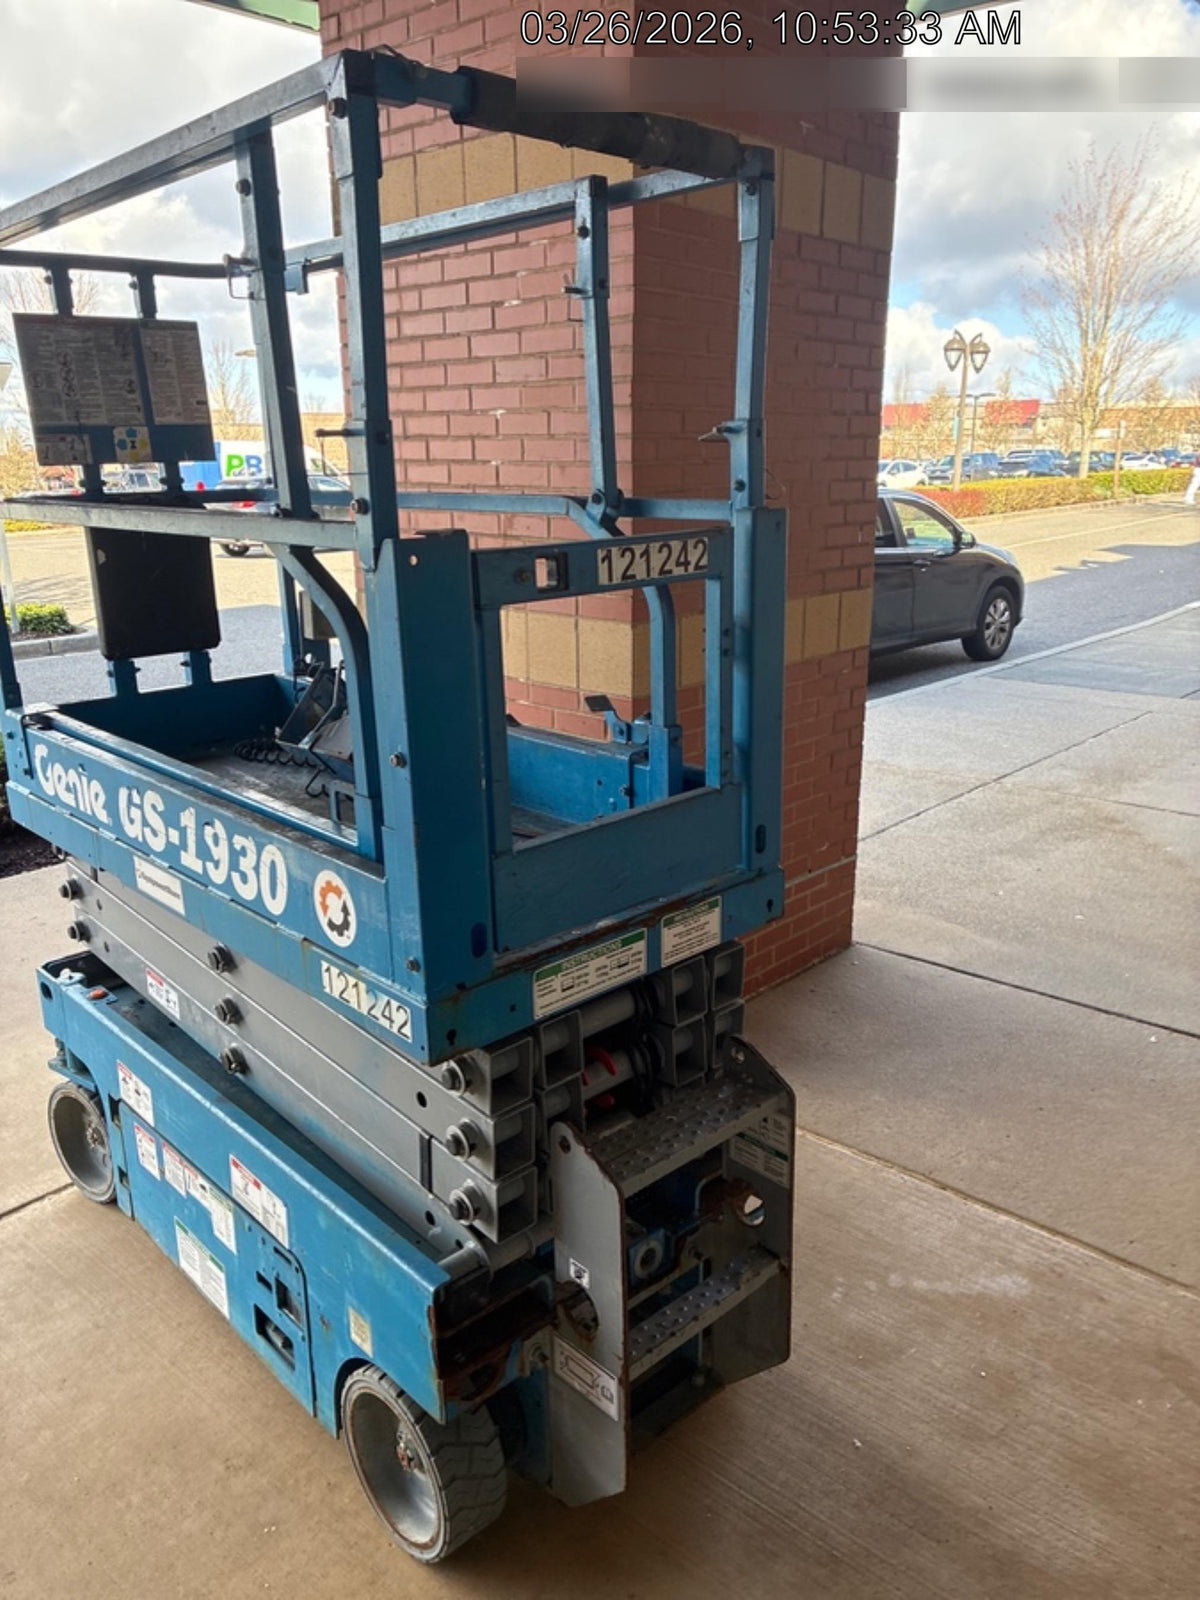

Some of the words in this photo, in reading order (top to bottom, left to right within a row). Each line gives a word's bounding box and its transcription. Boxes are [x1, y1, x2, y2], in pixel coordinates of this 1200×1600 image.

[601, 540, 708, 582] 121242
[35, 743, 110, 824] Genie
[118, 786, 288, 916] GS-1930
[325, 966, 410, 1039] 121242
